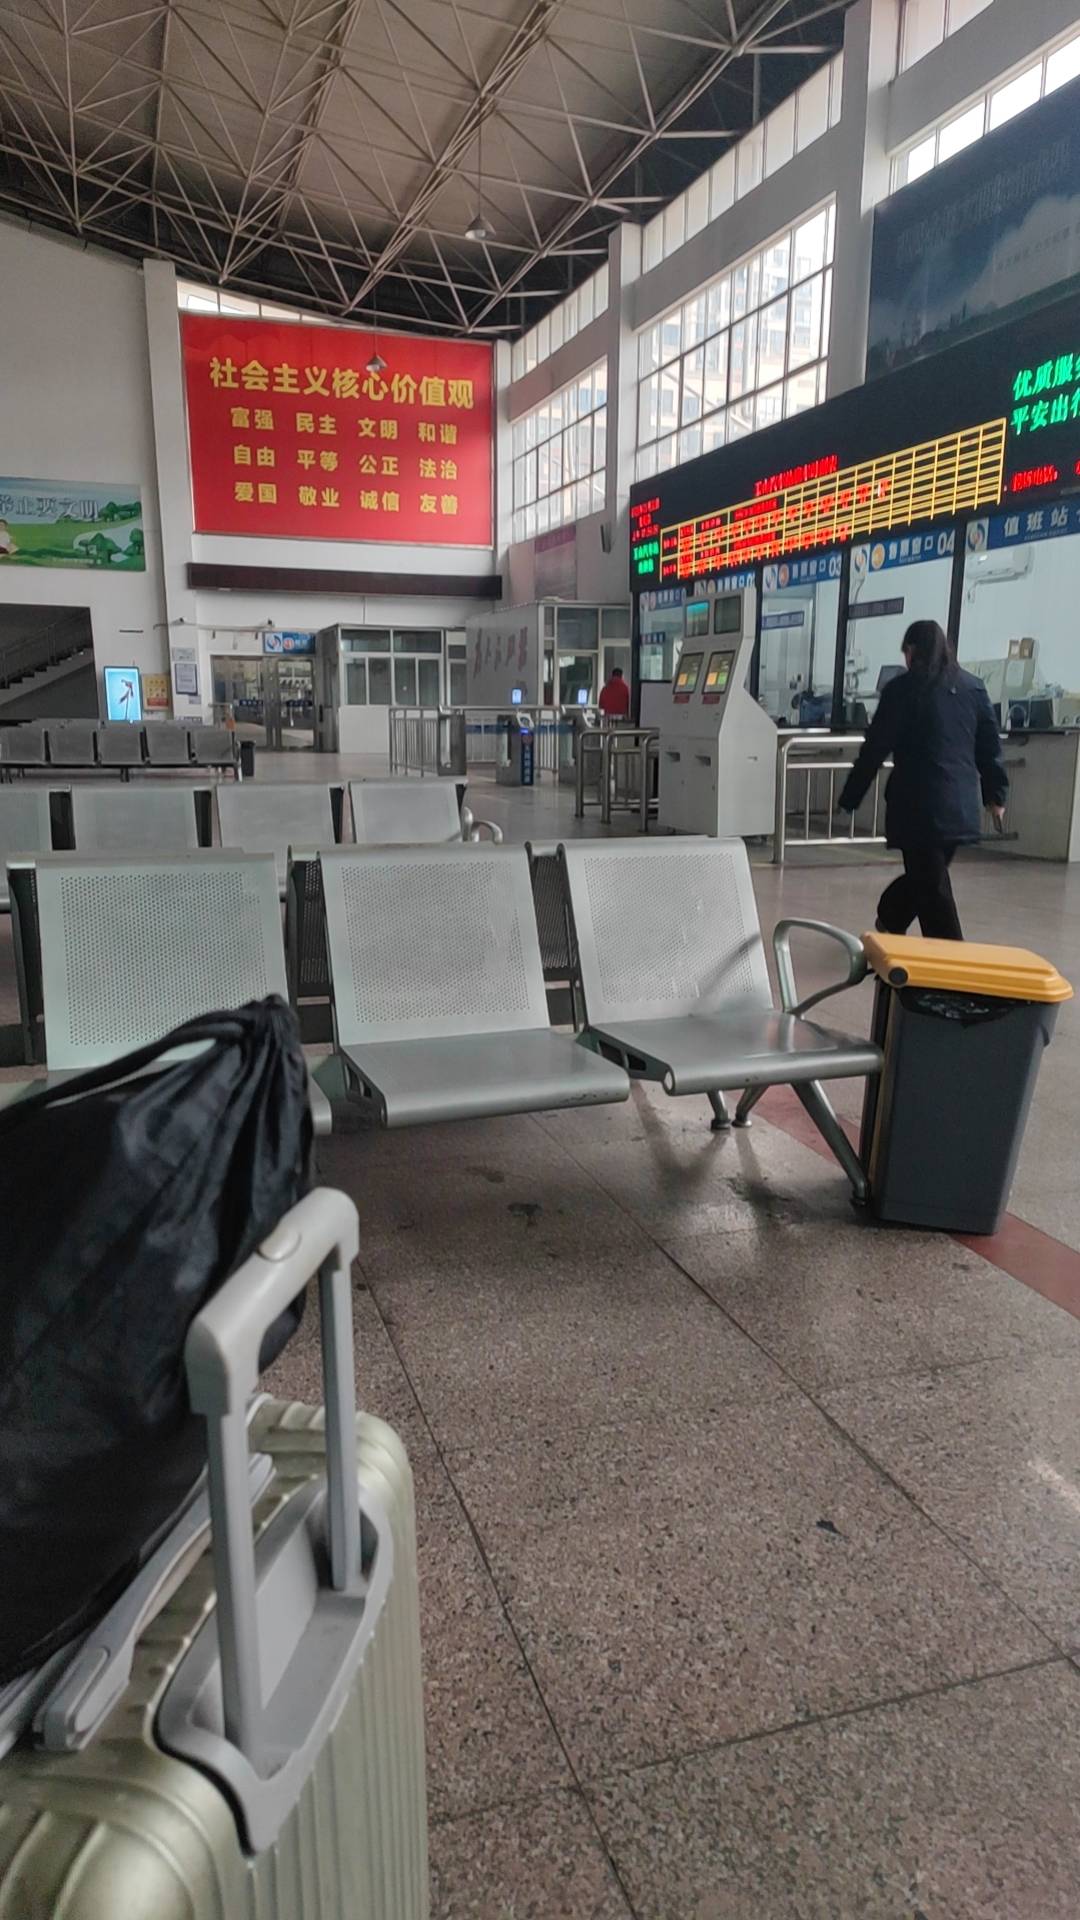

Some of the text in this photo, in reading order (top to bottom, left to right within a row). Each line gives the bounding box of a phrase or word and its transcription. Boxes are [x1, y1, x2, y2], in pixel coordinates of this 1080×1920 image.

[209, 357, 474, 409] 社会主义核心价值观
[230, 406, 457, 445] 富强 民主 文明 和谐
[234, 444, 457, 480] 自由 平等 公正 法治
[235, 482, 457, 515] 爱国 敬业 诚信 友善
[1004, 505, 1080, 538] 值班站
